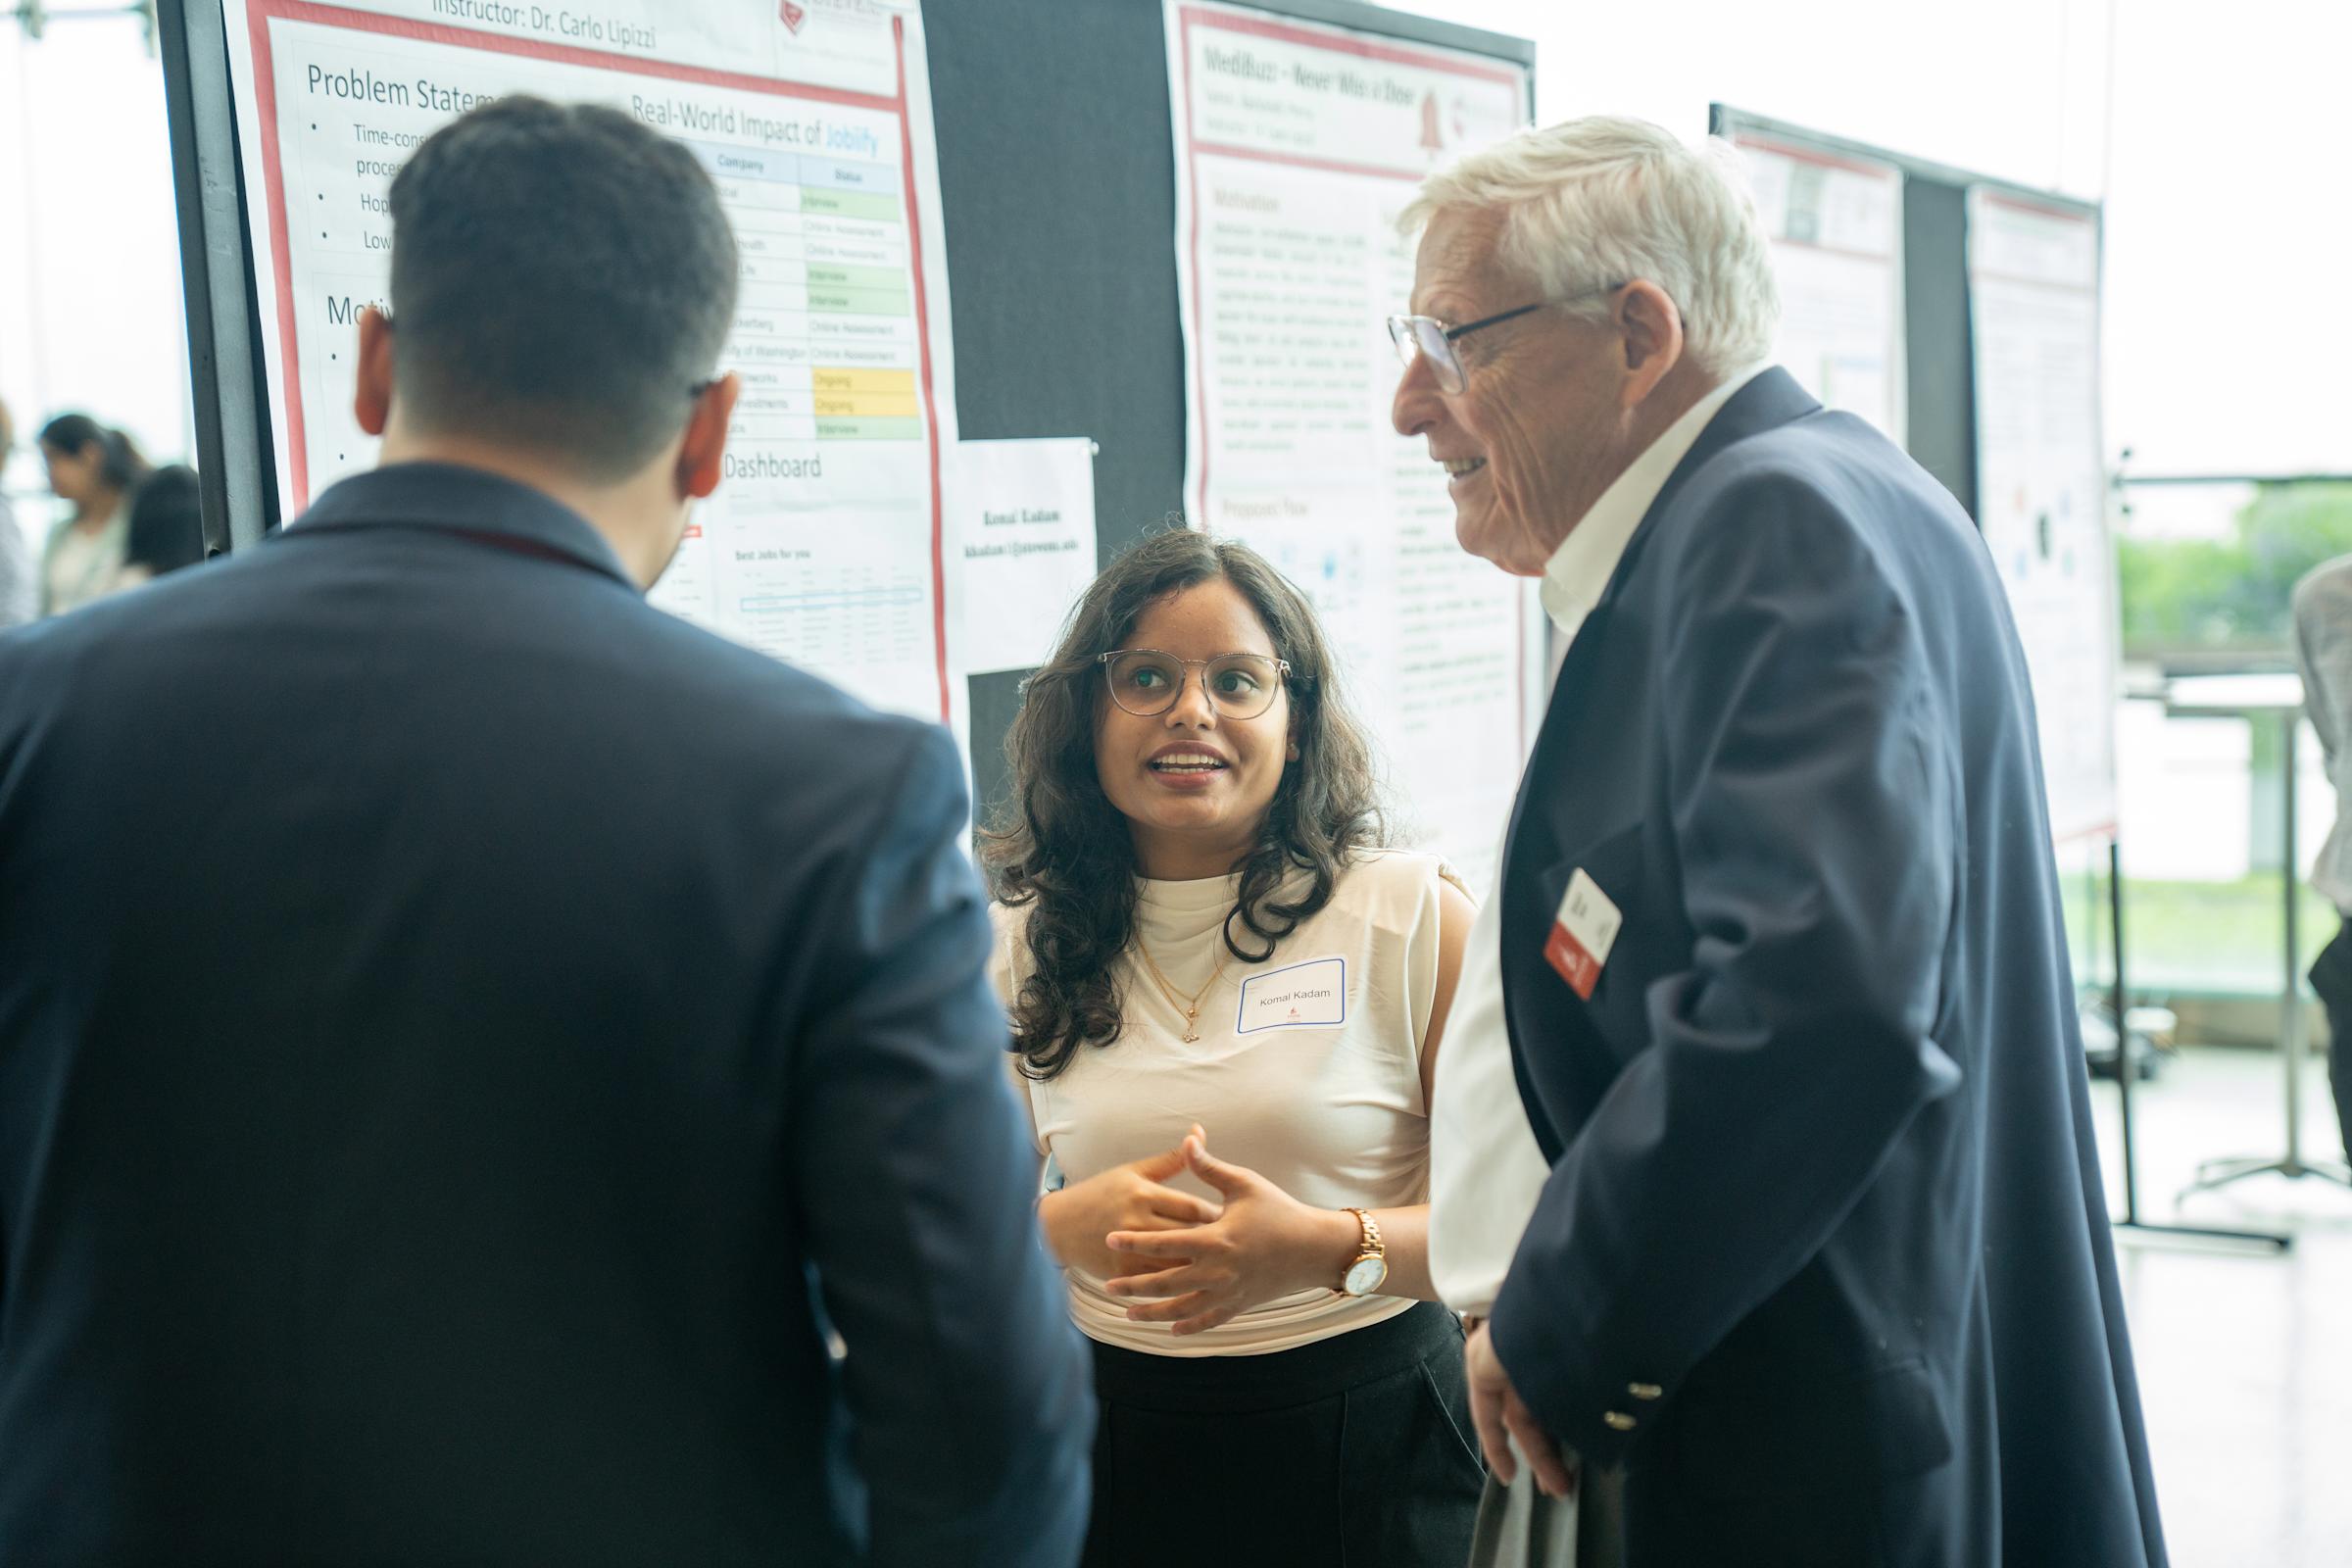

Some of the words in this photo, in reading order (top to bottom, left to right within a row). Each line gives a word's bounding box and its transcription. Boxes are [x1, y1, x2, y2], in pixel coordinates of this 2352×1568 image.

[531, 6, 555, 31] Dr.
[560, 12, 603, 40] Carlo
[608, 20, 657, 48] Lipizzi
[308, 65, 410, 106] Problem
[632, 95, 735, 133] Real-World
[741, 116, 800, 144] Impact
[806, 119, 822, 145] of
[725, 452, 822, 478] Dashboard
[1260, 992, 1291, 1006] Komal
[1293, 988, 1331, 1001] Kadam
